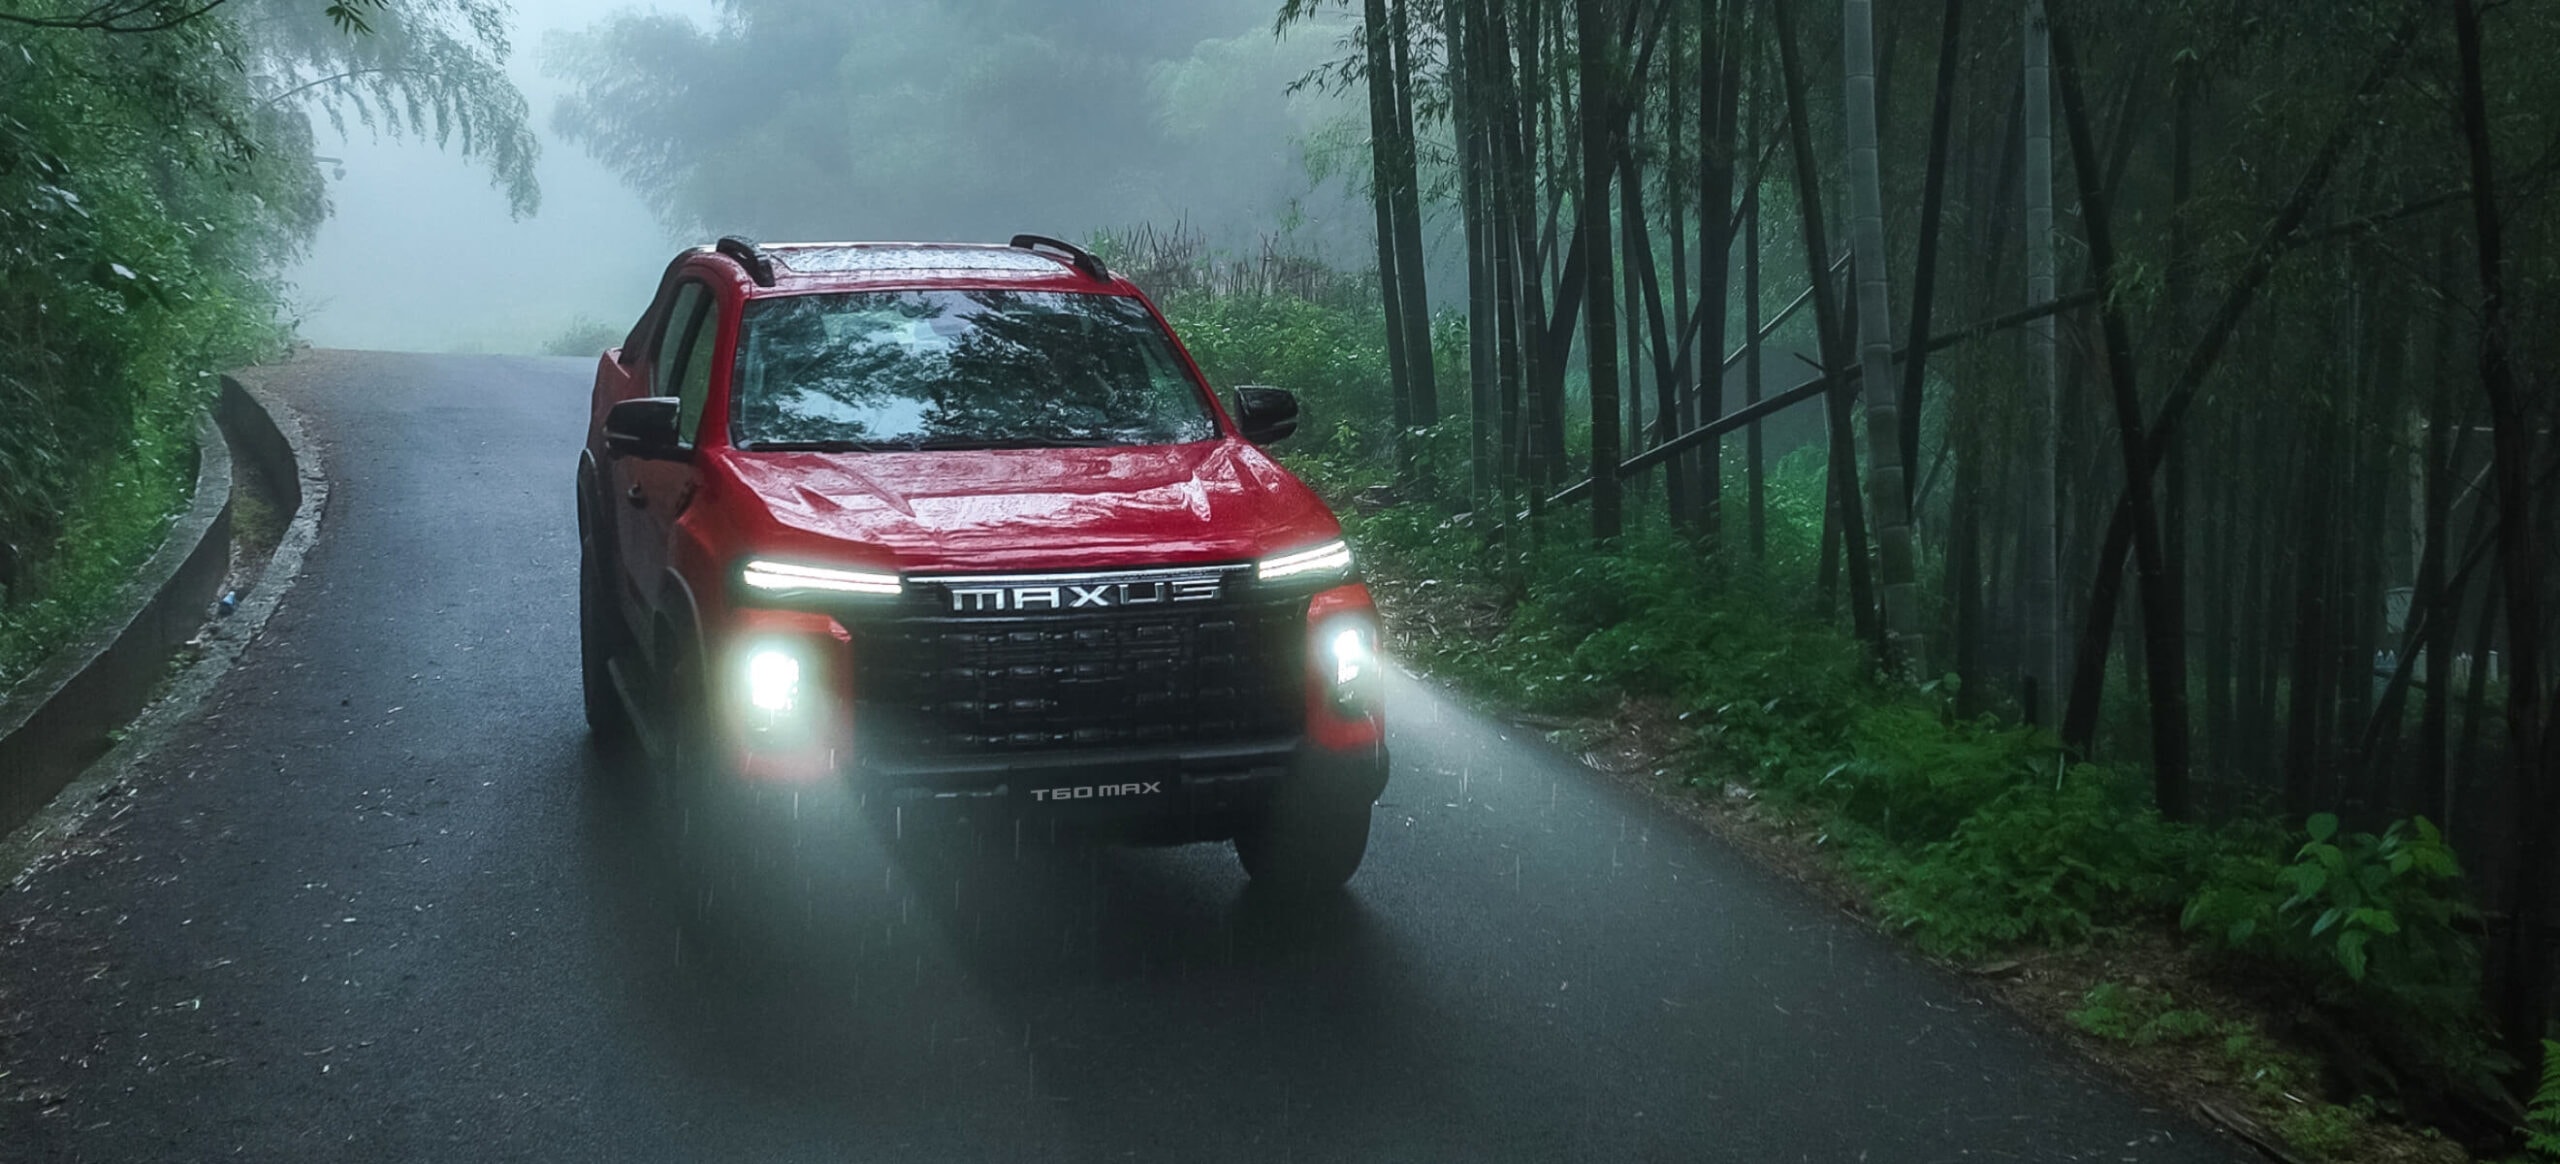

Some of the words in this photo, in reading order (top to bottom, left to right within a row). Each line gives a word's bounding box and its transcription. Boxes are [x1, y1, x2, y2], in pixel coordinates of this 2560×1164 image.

[951, 578, 1221, 611] MAXUS
[1030, 785, 1093, 801] T60
[1098, 781, 1161, 797] MAX
